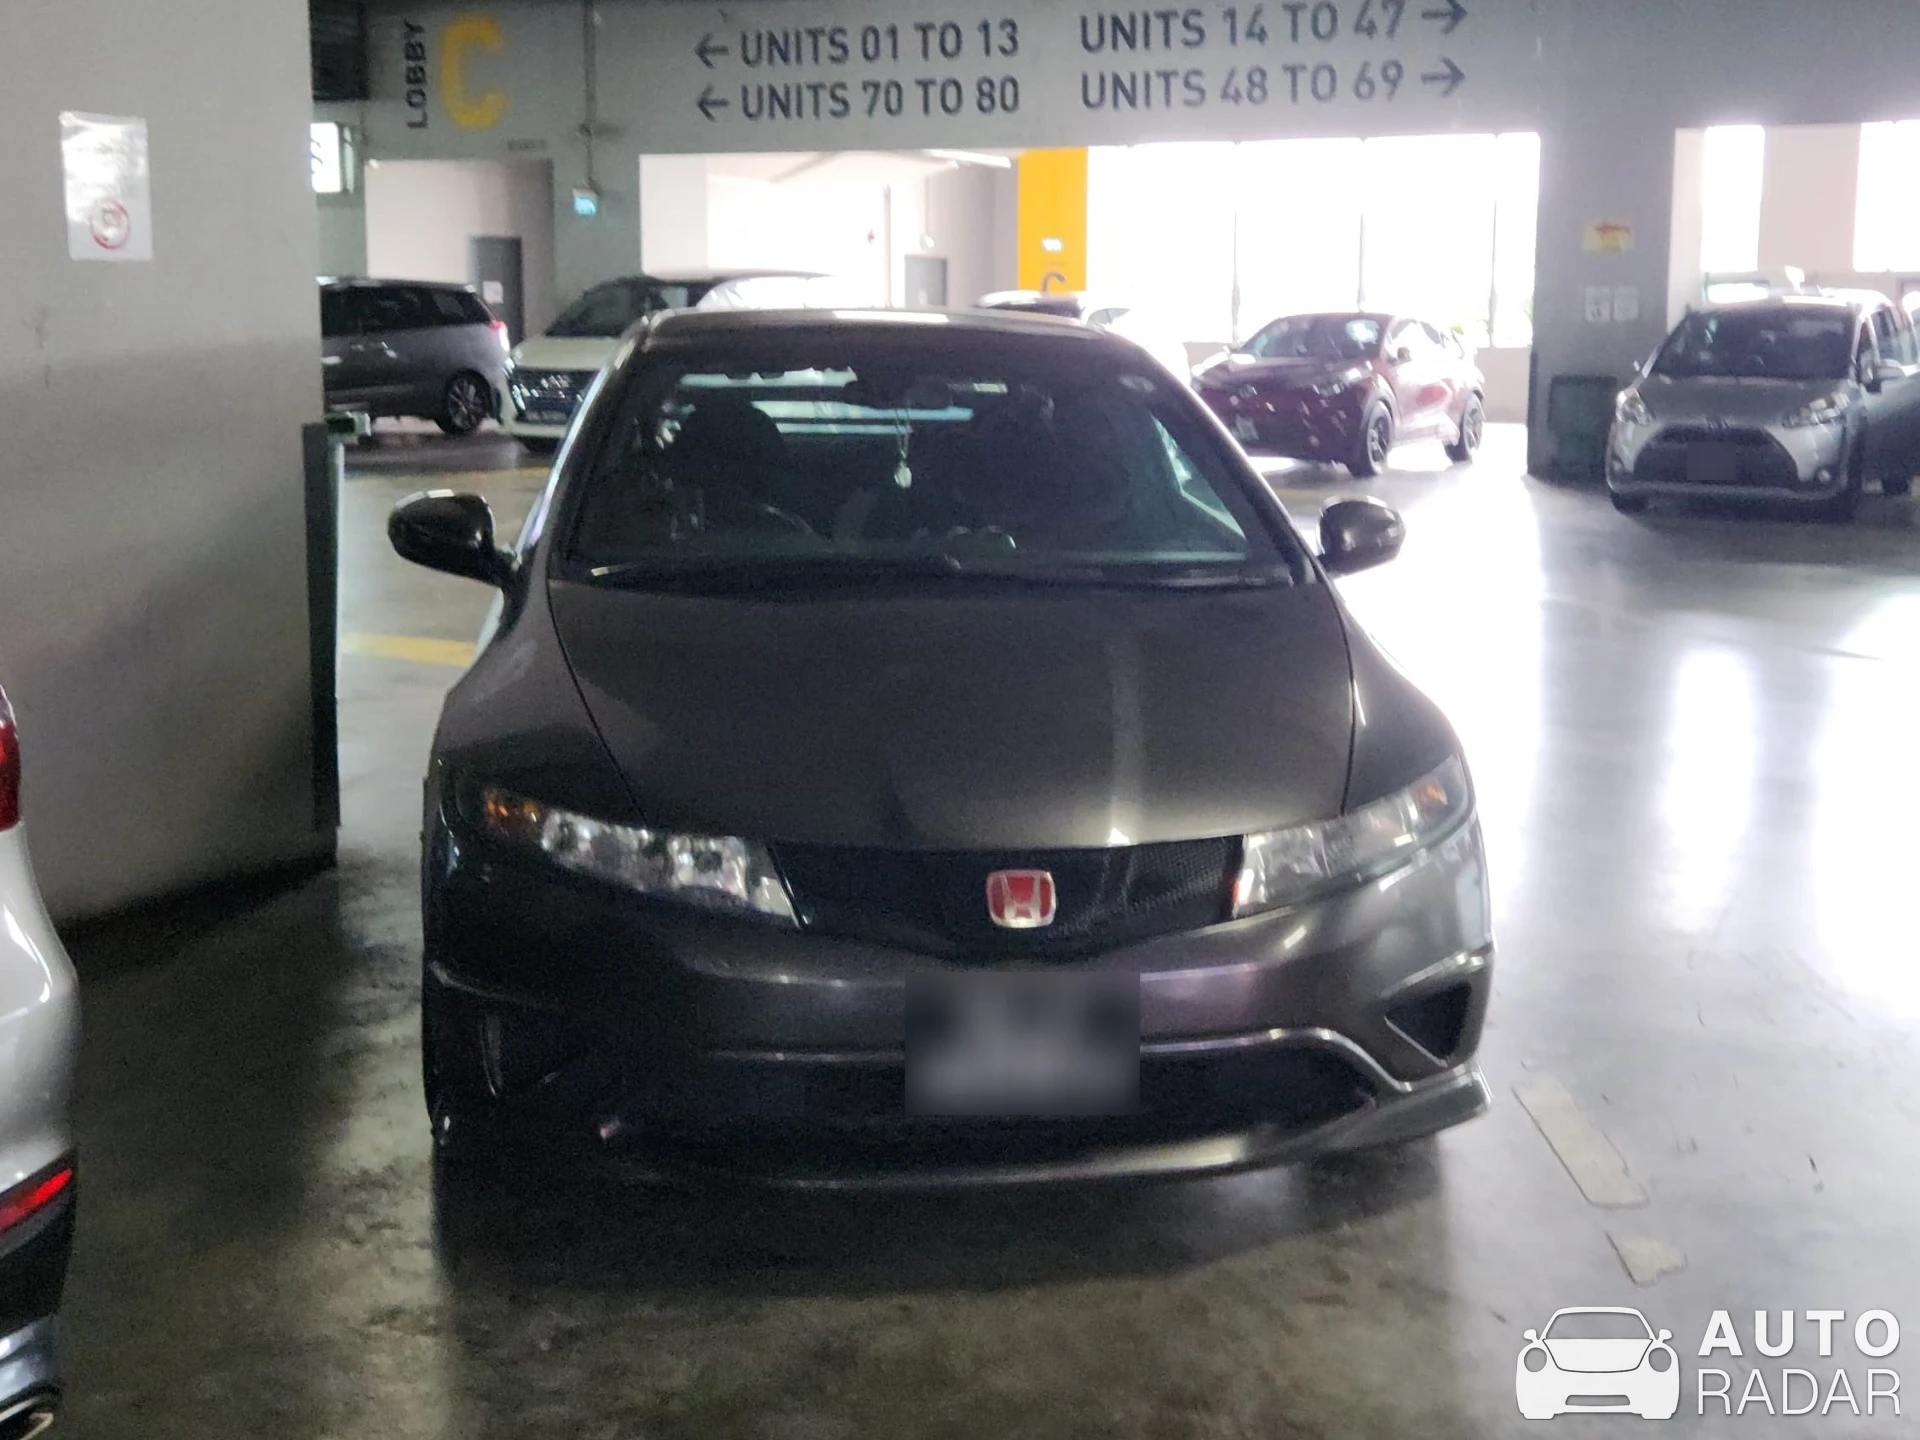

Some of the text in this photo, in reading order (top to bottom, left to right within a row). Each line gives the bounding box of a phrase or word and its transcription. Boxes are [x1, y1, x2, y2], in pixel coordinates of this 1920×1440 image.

[740, 18, 1019, 67] UNITS 01 TO 13
[1080, 0, 1404, 53] UNITS 14 TO 47
[403, 18, 428, 130] LOBBY
[439, 11, 508, 129] C
[1081, 60, 1403, 110] UNITS 48 TO 69
[741, 75, 1020, 120] UNITS 70 TO 80
